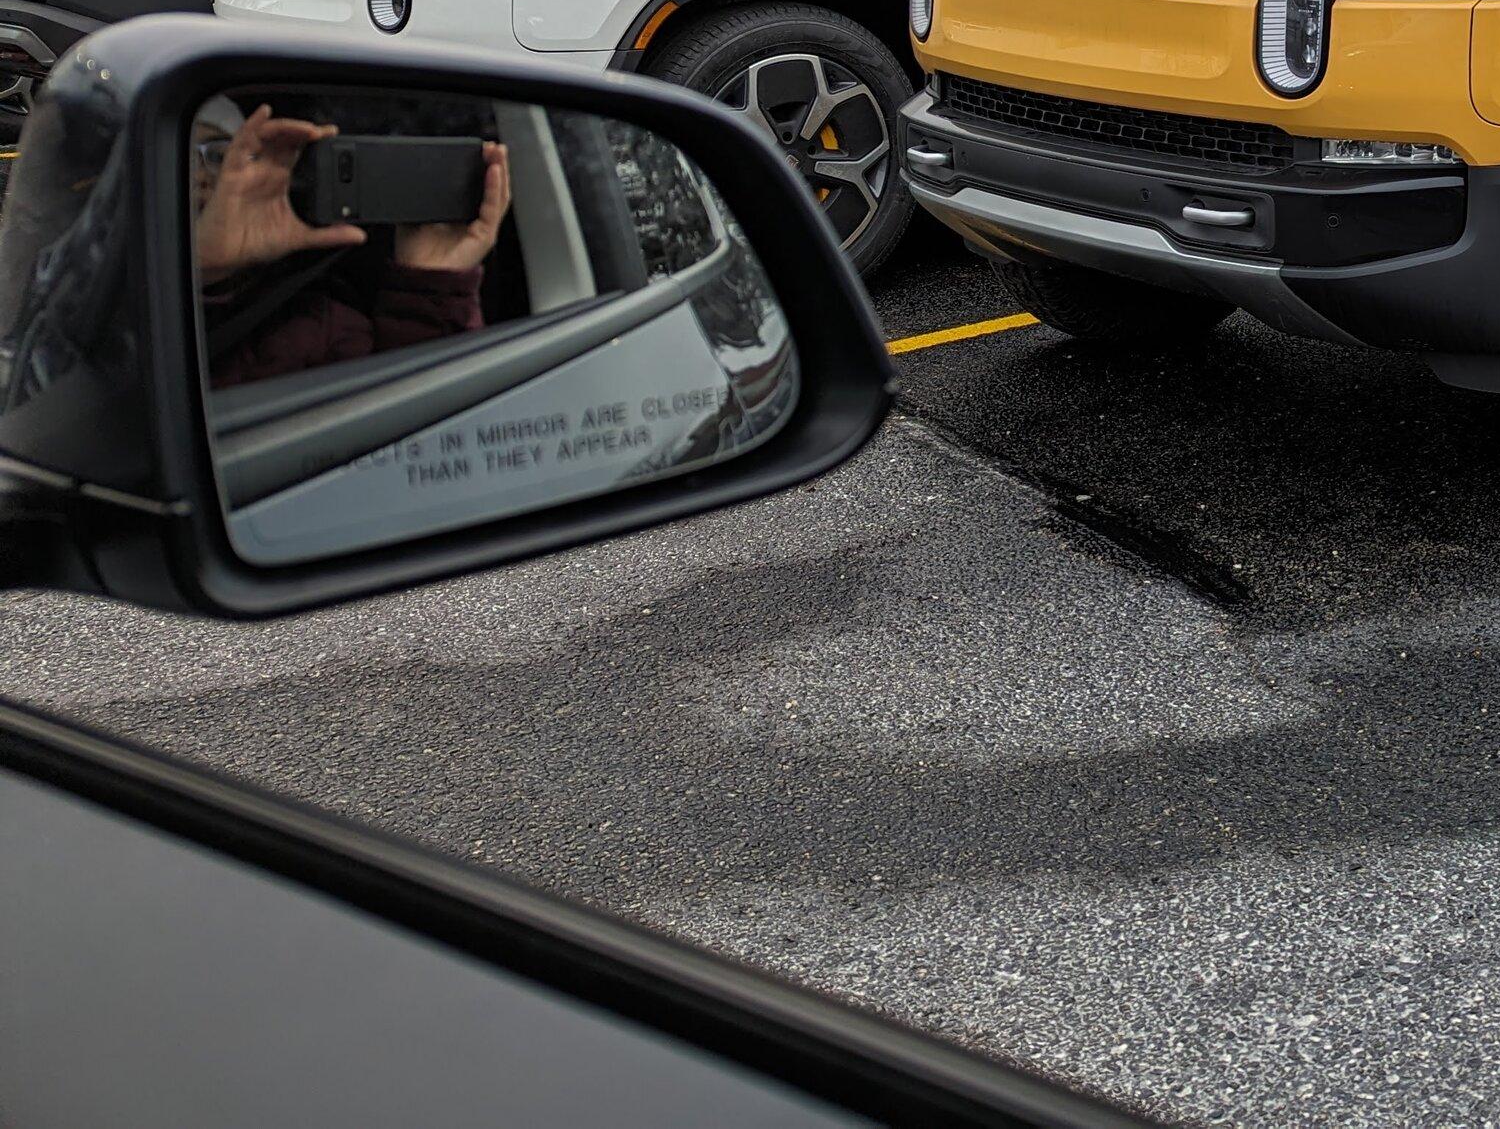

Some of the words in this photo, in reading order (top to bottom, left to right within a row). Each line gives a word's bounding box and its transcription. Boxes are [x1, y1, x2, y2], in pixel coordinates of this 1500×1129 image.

[407, 459, 471, 487] THAN
[485, 443, 544, 474] THEY
[556, 425, 652, 463] APPEAR
[440, 432, 464, 454] IN
[477, 412, 570, 448] MIRROR
[581, 402, 629, 429] ARE
